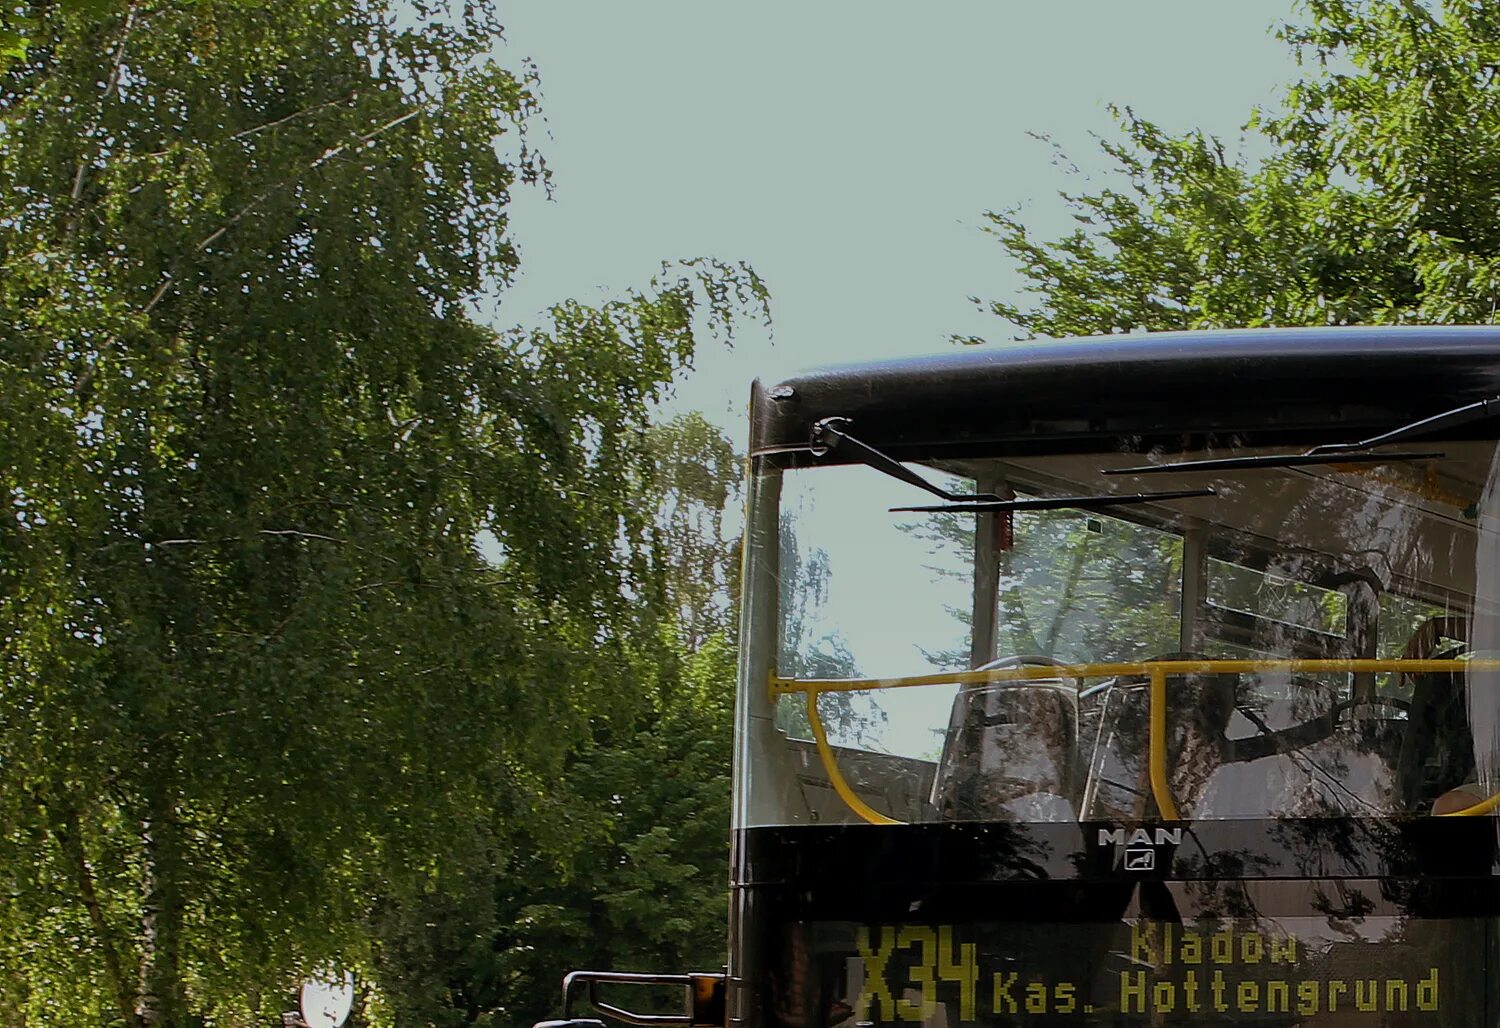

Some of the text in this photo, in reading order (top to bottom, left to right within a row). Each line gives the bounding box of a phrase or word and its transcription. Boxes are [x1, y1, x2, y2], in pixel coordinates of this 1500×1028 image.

[1099, 828, 1181, 845] MAN
[1131, 923, 1297, 965] Kladow
[855, 925, 979, 1023] X34
[993, 968, 1440, 1016] Kas. Hottengrund
